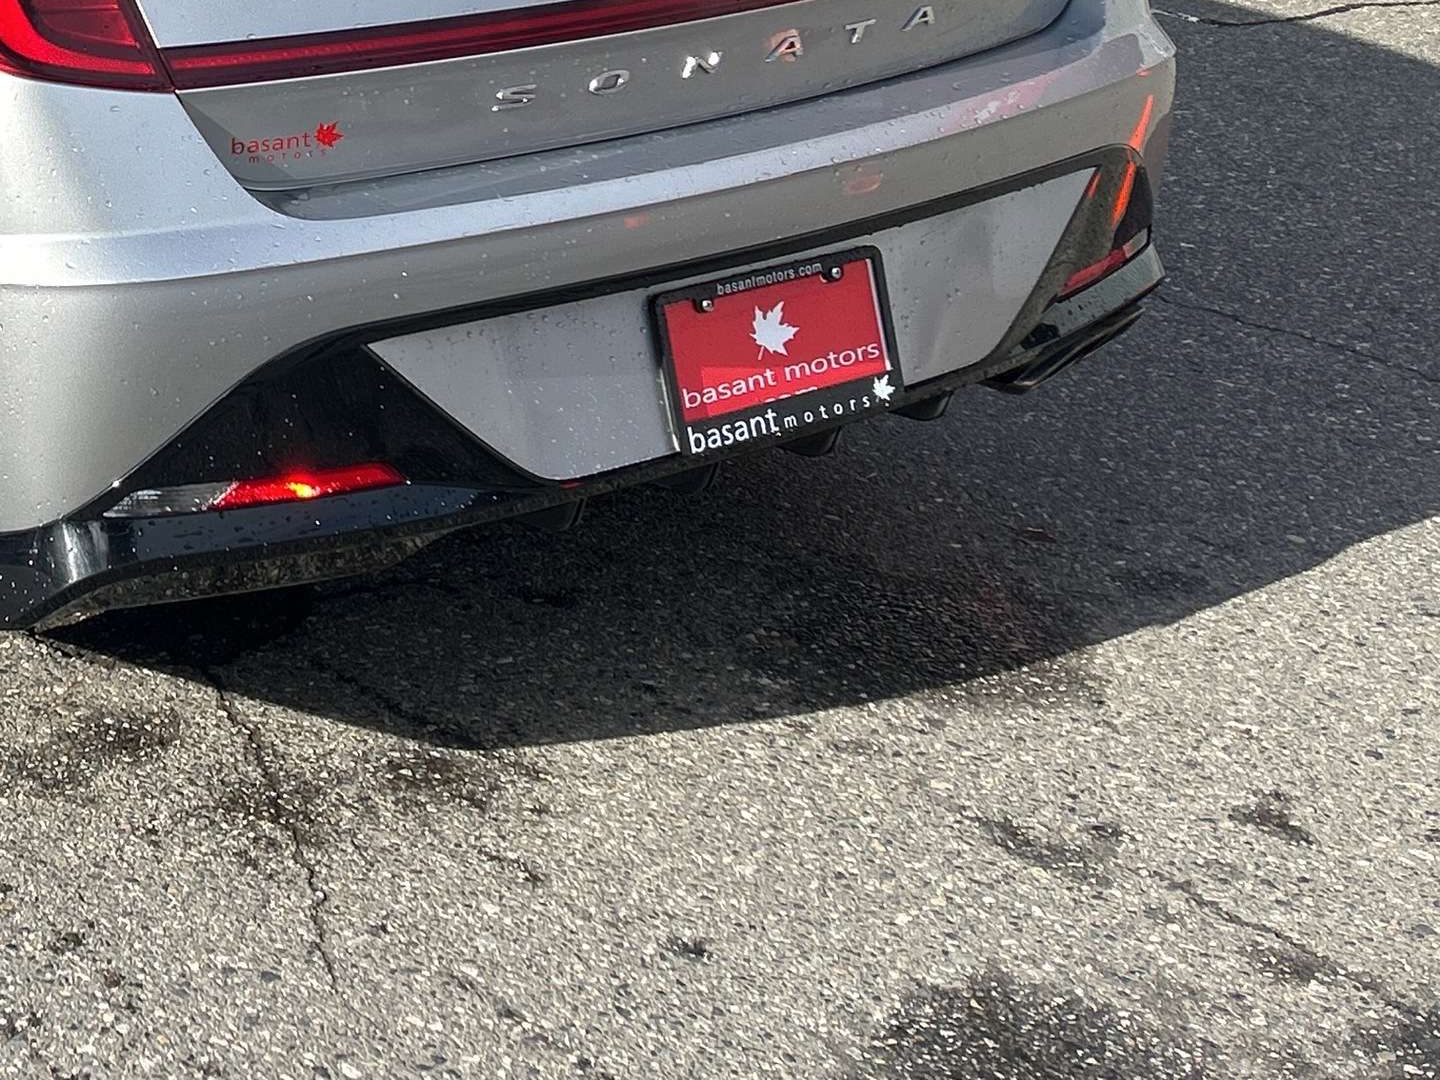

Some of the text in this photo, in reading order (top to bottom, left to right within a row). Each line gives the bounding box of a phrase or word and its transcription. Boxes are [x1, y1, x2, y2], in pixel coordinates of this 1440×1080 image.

[491, 4, 936, 112] SONATA
[230, 130, 312, 156] basant
[716, 262, 824, 296] basantmotors.com
[681, 367, 777, 410] basant
[784, 341, 882, 383] motors
[686, 408, 781, 455] basant
[783, 394, 872, 430] motors
